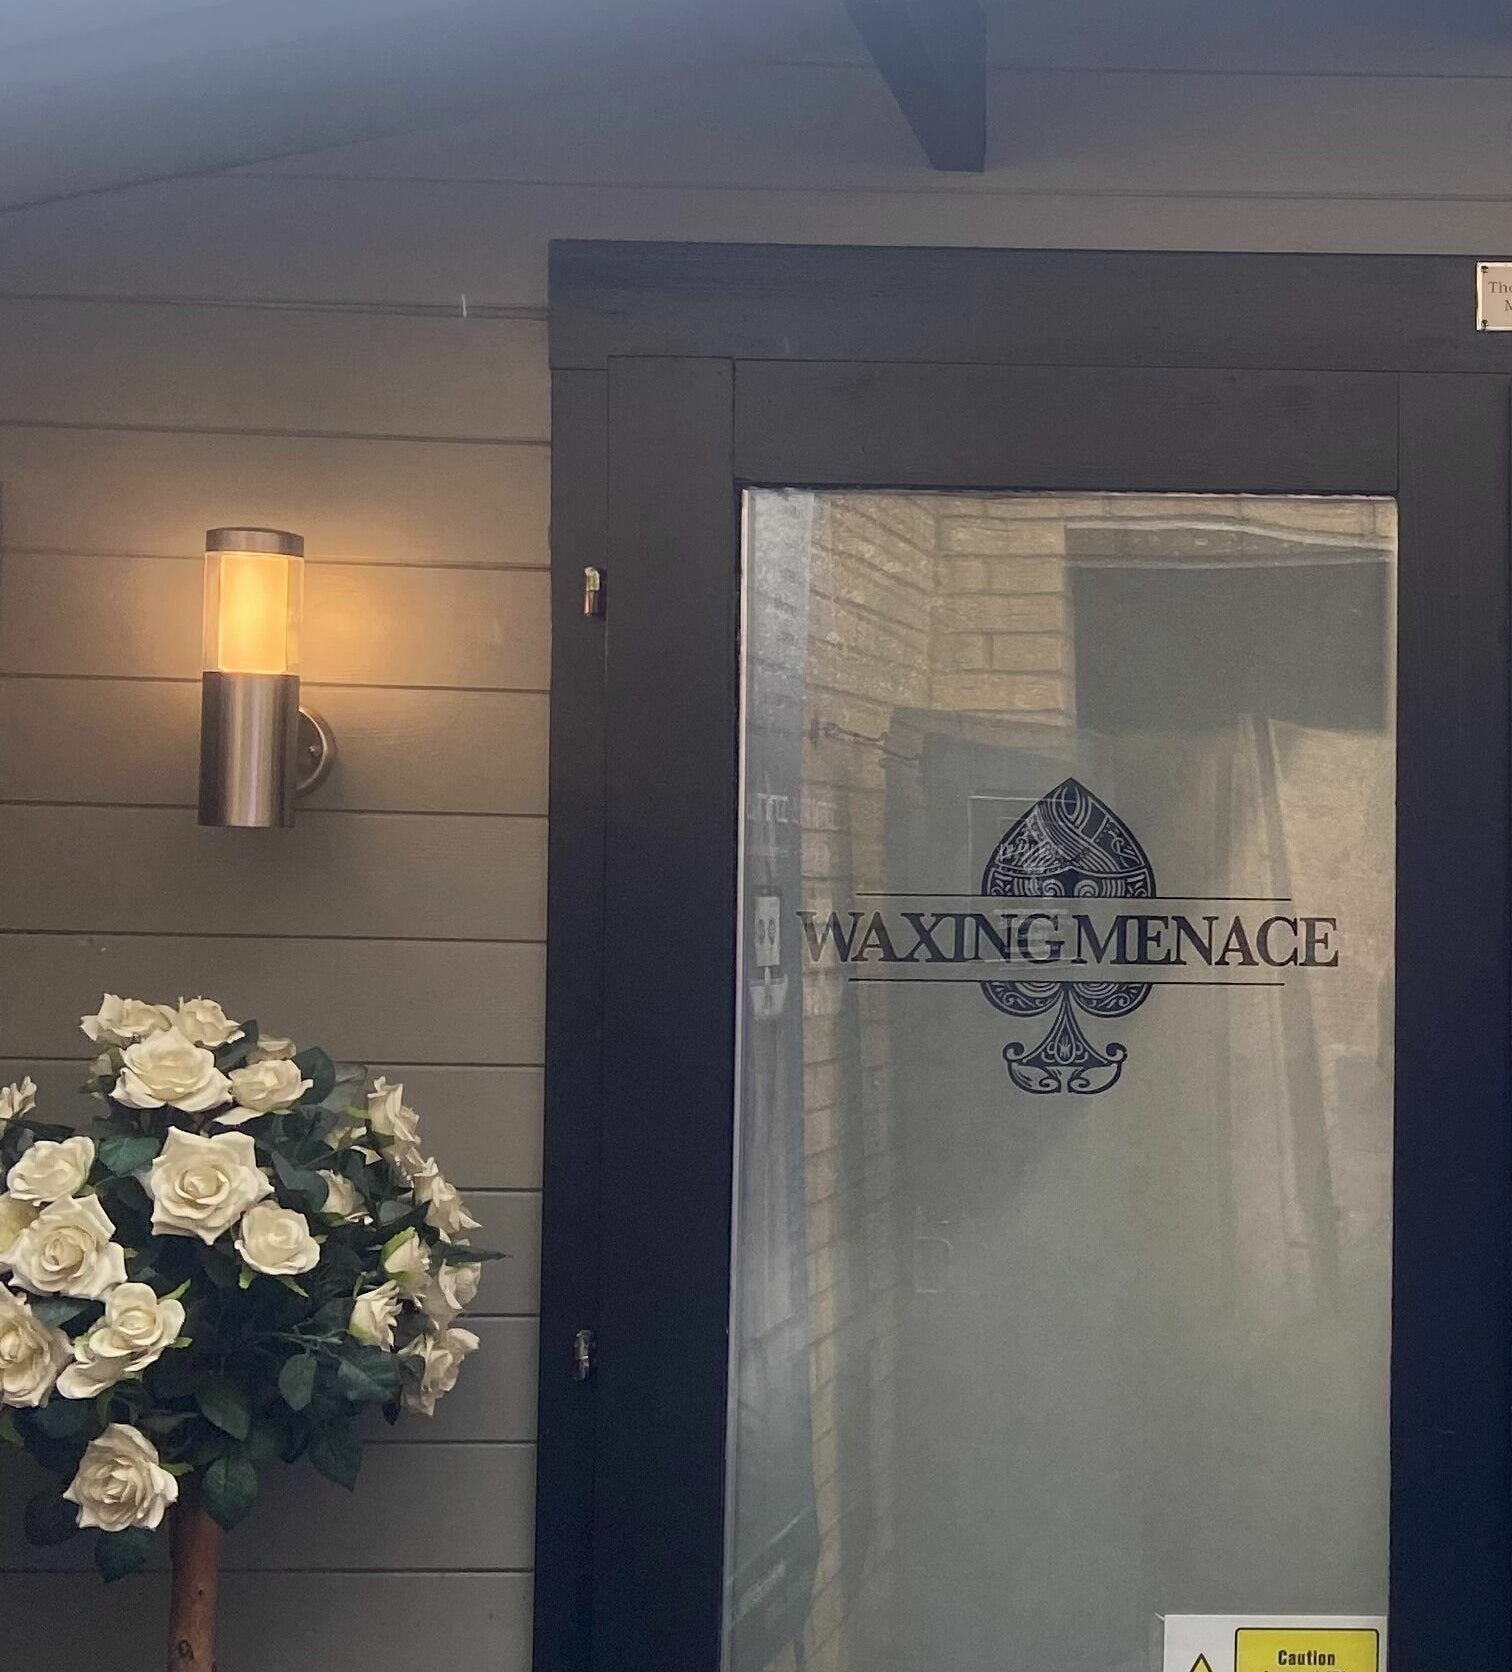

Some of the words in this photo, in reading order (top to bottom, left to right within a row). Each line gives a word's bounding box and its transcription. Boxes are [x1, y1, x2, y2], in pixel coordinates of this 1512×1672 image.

[796, 910, 1064, 966] WAXING
[1072, 914, 1340, 968] MENACE
[1277, 1649, 1336, 1666] Caution
